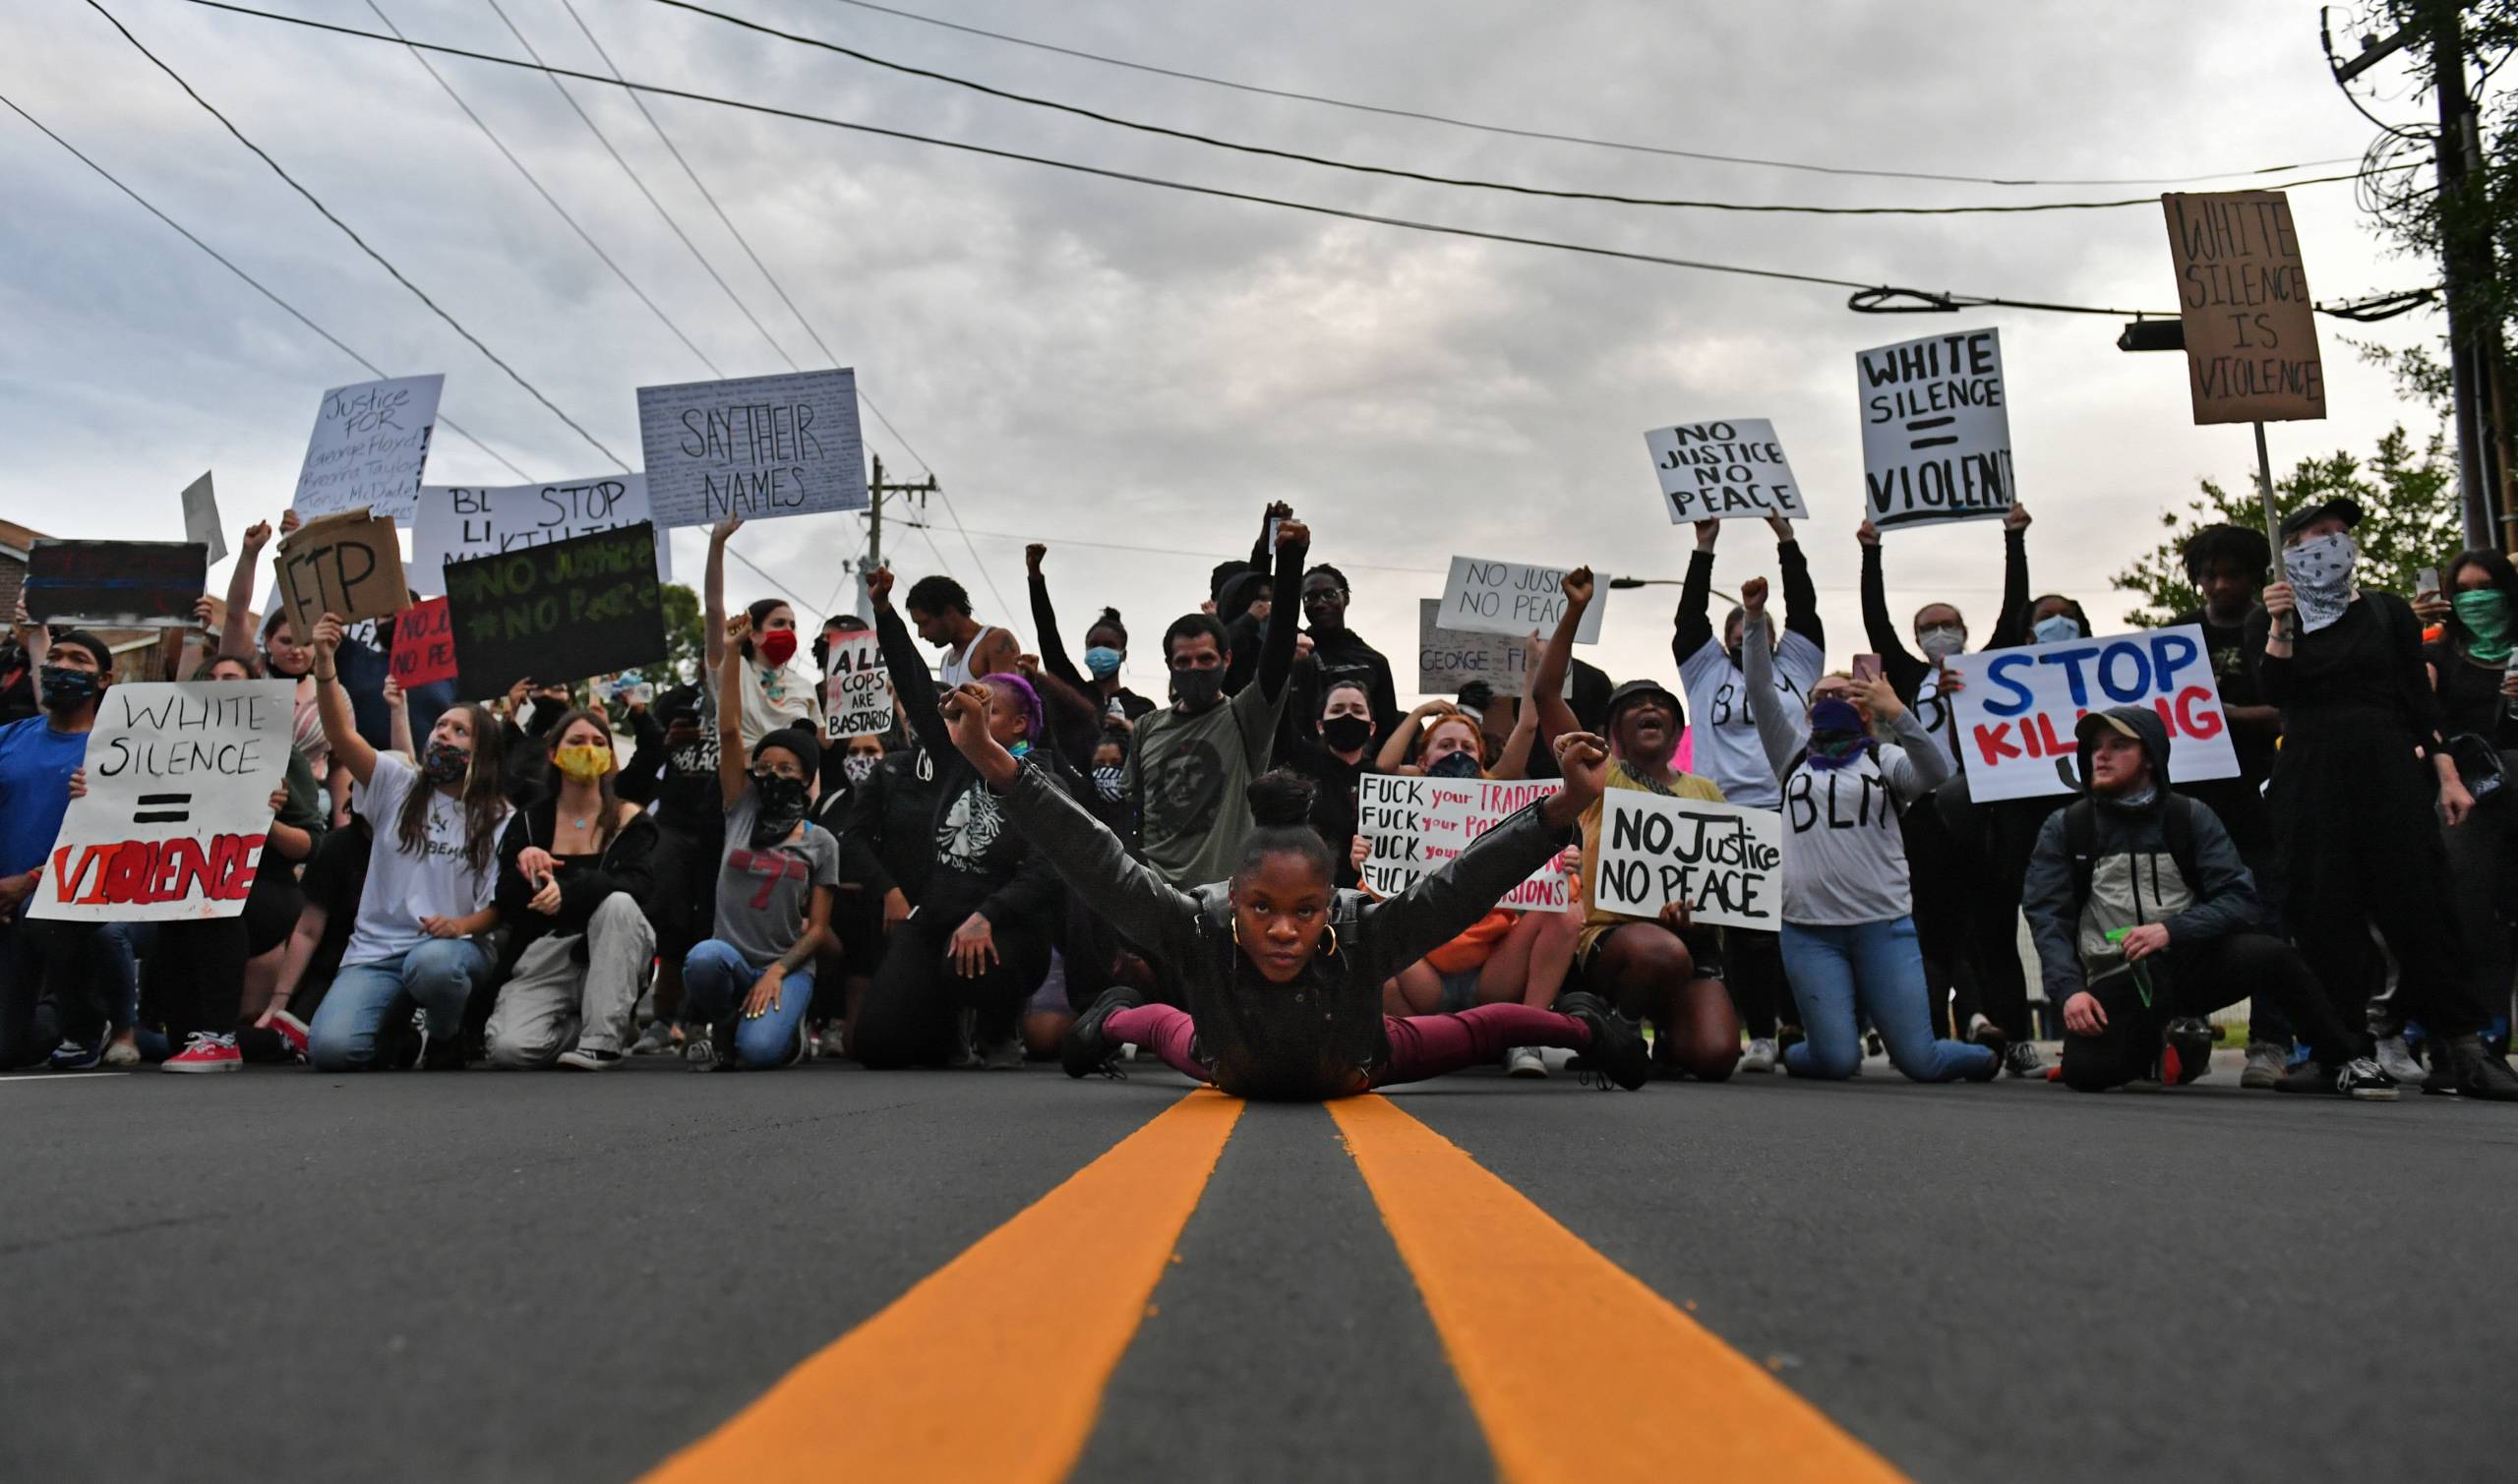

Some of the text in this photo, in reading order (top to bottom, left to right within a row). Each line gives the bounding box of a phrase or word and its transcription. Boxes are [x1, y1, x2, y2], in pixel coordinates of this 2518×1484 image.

[2176, 199, 2299, 262] WHITE
[2186, 264, 2309, 310] SILENCE
[2227, 312, 2279, 349] IS
[1863, 333, 1995, 387] WHITE
[2196, 355, 2321, 401] VIOLENCE
[325, 386, 410, 421] Justice
[1870, 379, 2001, 423] SILENCE
[344, 409, 404, 440] FOR
[681, 407, 734, 465] SAY
[730, 403, 825, 466] THEIR
[1674, 422, 1737, 446] NO
[1660, 442, 1784, 469] JUSTICE
[705, 466, 806, 518] NAMES
[1694, 464, 1754, 486] NO
[537, 480, 626, 527] STOP
[1670, 484, 1797, 516] PEACE
[286, 540, 376, 625] FTP
[1466, 564, 1508, 588] NO
[1459, 590, 1567, 623] NO PEAC
[398, 611, 430, 645] NO
[830, 645, 887, 677] ALL
[1419, 648, 1489, 672] GEORGE
[1982, 634, 2198, 716] STOP
[842, 670, 885, 693] COPS
[123, 694, 266, 731] WHITE
[852, 692, 876, 709] ARE
[829, 706, 891, 736] BASTARDS
[99, 737, 261, 777] SILENCE
[1362, 777, 1424, 806] FUCK
[1432, 788, 1473, 809] your
[1788, 772, 1888, 834] BLM
[1361, 806, 1420, 832] FUCK
[1422, 816, 1460, 834] your
[1612, 807, 1781, 871] NO Justice
[53, 833, 268, 905] VIOLENCE
[1363, 864, 1420, 894] FUCK
[1600, 859, 1650, 905] NO
[1658, 864, 1770, 919] PEACE
